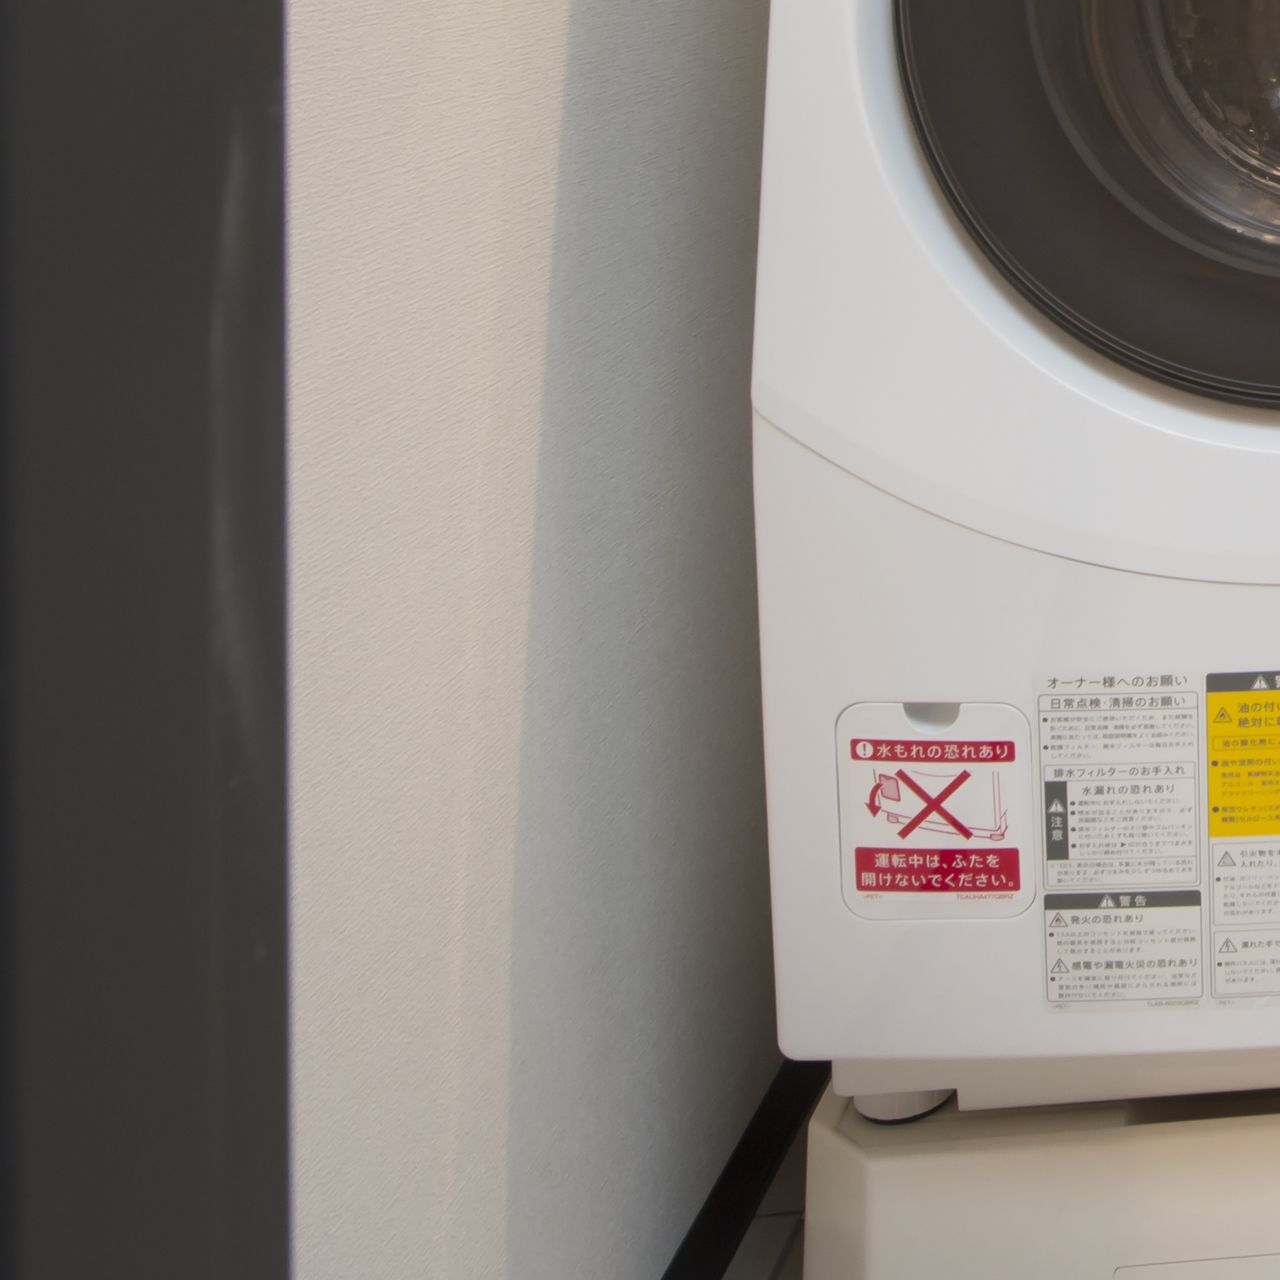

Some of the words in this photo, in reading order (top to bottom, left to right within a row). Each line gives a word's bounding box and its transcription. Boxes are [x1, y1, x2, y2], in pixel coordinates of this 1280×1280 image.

[1048, 675, 1188, 688] オーナー様へのお願い
[877, 744, 1008, 758] 水もれの恐れあり
[875, 854, 999, 868] 運転中は、ふたを
[861, 873, 1014, 887] 開けないでください。
